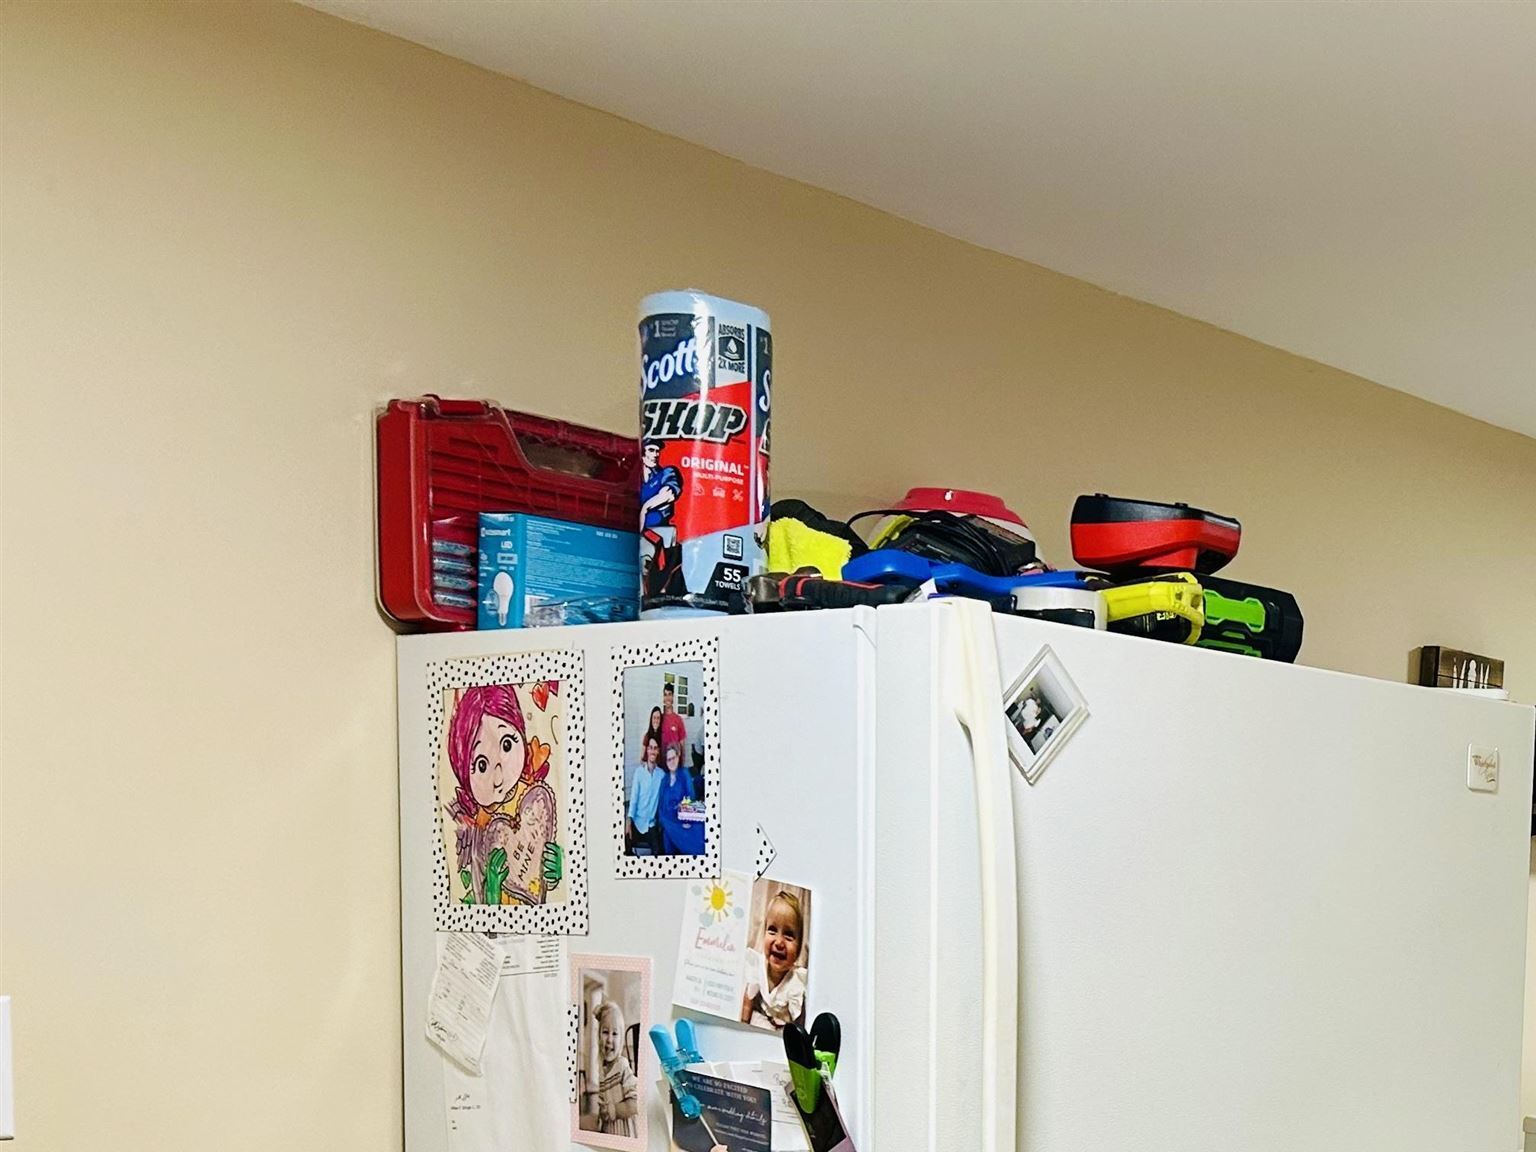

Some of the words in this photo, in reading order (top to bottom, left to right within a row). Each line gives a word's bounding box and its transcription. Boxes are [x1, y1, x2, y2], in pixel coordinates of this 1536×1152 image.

[718, 322, 746, 342] ABSORBS
[728, 360, 746, 375] MORE
[642, 398, 748, 443] SHOP
[681, 455, 745, 477] ORIGINAL
[722, 566, 742, 583] 55
[714, 580, 742, 591] TOWELS
[512, 841, 525, 861] BE
[517, 841, 536, 882] MINE
